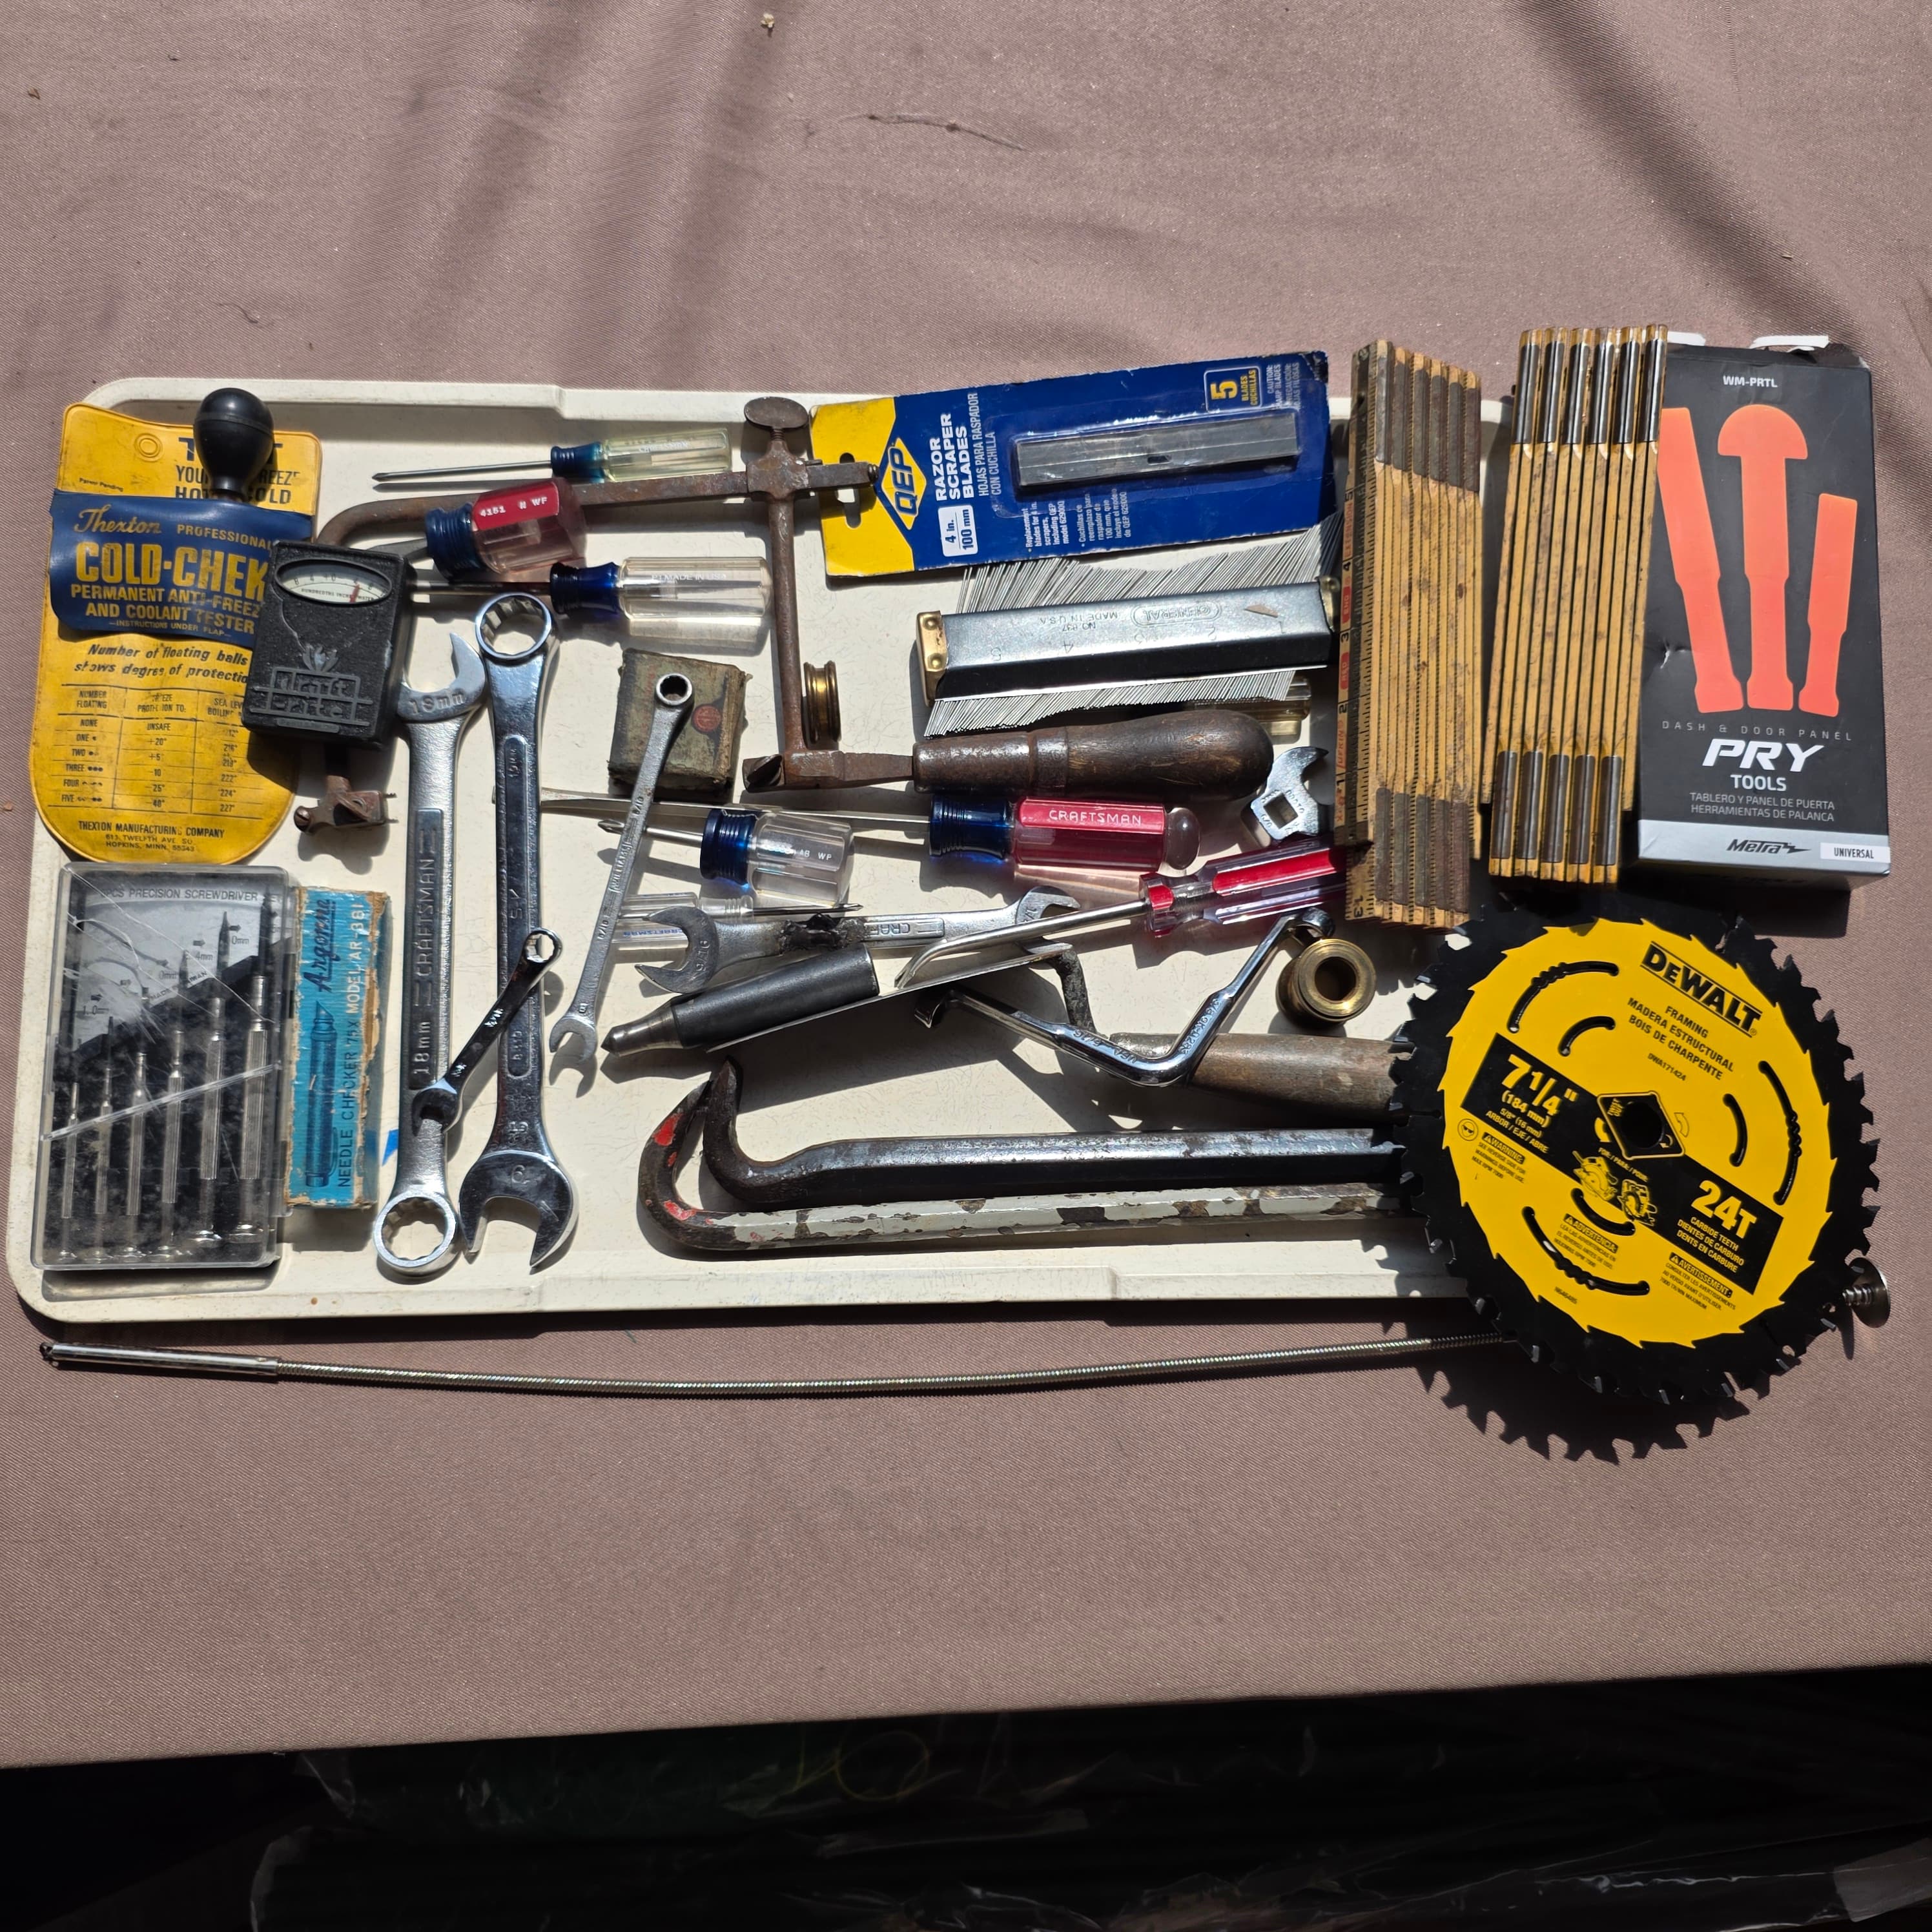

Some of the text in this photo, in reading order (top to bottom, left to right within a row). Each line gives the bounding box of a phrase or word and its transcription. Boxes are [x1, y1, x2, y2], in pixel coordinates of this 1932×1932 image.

[1266, 364, 1275, 394] CAUTION:
[1273, 364, 1282, 389] BLADES
[1292, 362, 1300, 389] FILOSAS
[1723, 375, 1778, 388] WM-PRTL
[1209, 380, 1238, 400] 5
[1240, 375, 1249, 402] BLADES
[1248, 369, 1259, 406] CUCHILLAS
[940, 413, 961, 500] SCRAPER
[967, 393, 989, 497] HOJAS PARA RASPADOR
[929, 437, 947, 501] RAZOR
[956, 426, 974, 499] BLADES
[985, 431, 1002, 496] CON CUCHILLA
[888, 446, 919, 515] QEP
[1103, 499, 1111, 512] que
[1111, 488, 1119, 510] modelo
[1344, 491, 1355, 502] 5
[74, 504, 162, 535] Thexton
[1048, 503, 1056, 516] QEP
[945, 519, 956, 544] 4 in.
[961, 509, 974, 551] 100 mm
[1021, 508, 1033, 548] Replacement
[1042, 517, 1052, 546] scrapers,
[1076, 512, 1086, 542] Cuchillas
[1085, 508, 1095, 542] reemplazo
[1094, 503, 1104, 540] raspador de
[1113, 516, 1122, 539] incluye
[1124, 529, 1131, 537] de
[1343, 502, 1354, 559] EXTENSION
[1034, 526, 1043, 547] blades
[1060, 524, 1069, 544] model
[1342, 561, 1351, 571] 4
[70, 583, 165, 603] PERMANENT
[85, 602, 256, 635] AND COOLANT TESTER
[1086, 611, 1118, 621] MADE
[1142, 604, 1211, 622] GENERAL
[170, 622, 199, 632] UNDER
[1339, 632, 1350, 642] 3
[88, 644, 249, 666] Number of floating balls
[1064, 641, 1074, 653] 4
[169, 663, 181, 675] of
[76, 700, 107, 710] FLOATING
[78, 690, 107, 699] NUMBER
[1338, 703, 1348, 714] 2
[79, 718, 171, 732] NONE UNSAFE
[1661, 720, 1852, 741] DASH & DOOR PANEL
[76, 734, 90, 743] ONE
[1336, 729, 1347, 769] LUFKIN
[72, 748, 86, 757] TWO
[1701, 738, 1825, 773] PRY
[65, 763, 85, 773] THREE
[63, 779, 80, 788] FOUR
[1336, 778, 1345, 786] 1
[1730, 774, 1787, 792] TOOLS
[61, 794, 75, 803] FIVE
[1689, 792, 1836, 810] TABLERO Y PANEL DE PUERTA
[1049, 809, 1142, 826] CRAFTSMAN
[1690, 804, 1835, 823] HERRAMIENTAS DE PALANCA
[78, 820, 113, 832] THEXTON
[185, 827, 225, 838] COMPANY
[1833, 847, 1875, 859] UNIVERSAL
[129, 888, 181, 899] PRECISION
[185, 889, 258, 901] SCREWDRIVER
[1353, 895, 1364, 919] 13
[304, 898, 340, 992] Argonne
[346, 903, 365, 1014] MODEL AR-381
[414, 859, 435, 1075] 18mm CRAFTSMAN
[1665, 1005, 1709, 1039] FRAMING
[1627, 997, 1734, 1073] MADERA ESTRUCTURAL
[1628, 1014, 1723, 1081] BOIS DE CHARPENTE
[342, 1051, 357, 1120] CHECKER
[1501, 1089, 1550, 1128] (184 mm)
[1485, 1110, 1550, 1154] ARBOR EJE ABRE
[1525, 1125, 1543, 1138] mm)
[337, 1129, 353, 1187] NEEDLE
[1690, 1180, 1758, 1239] 24T
[1677, 1218, 1745, 1267] DIENTES DE CARBURO
[1690, 1216, 1740, 1252] CARBIDE TEETH
[1676, 1229, 1739, 1273] DENTS EN CARBURE
